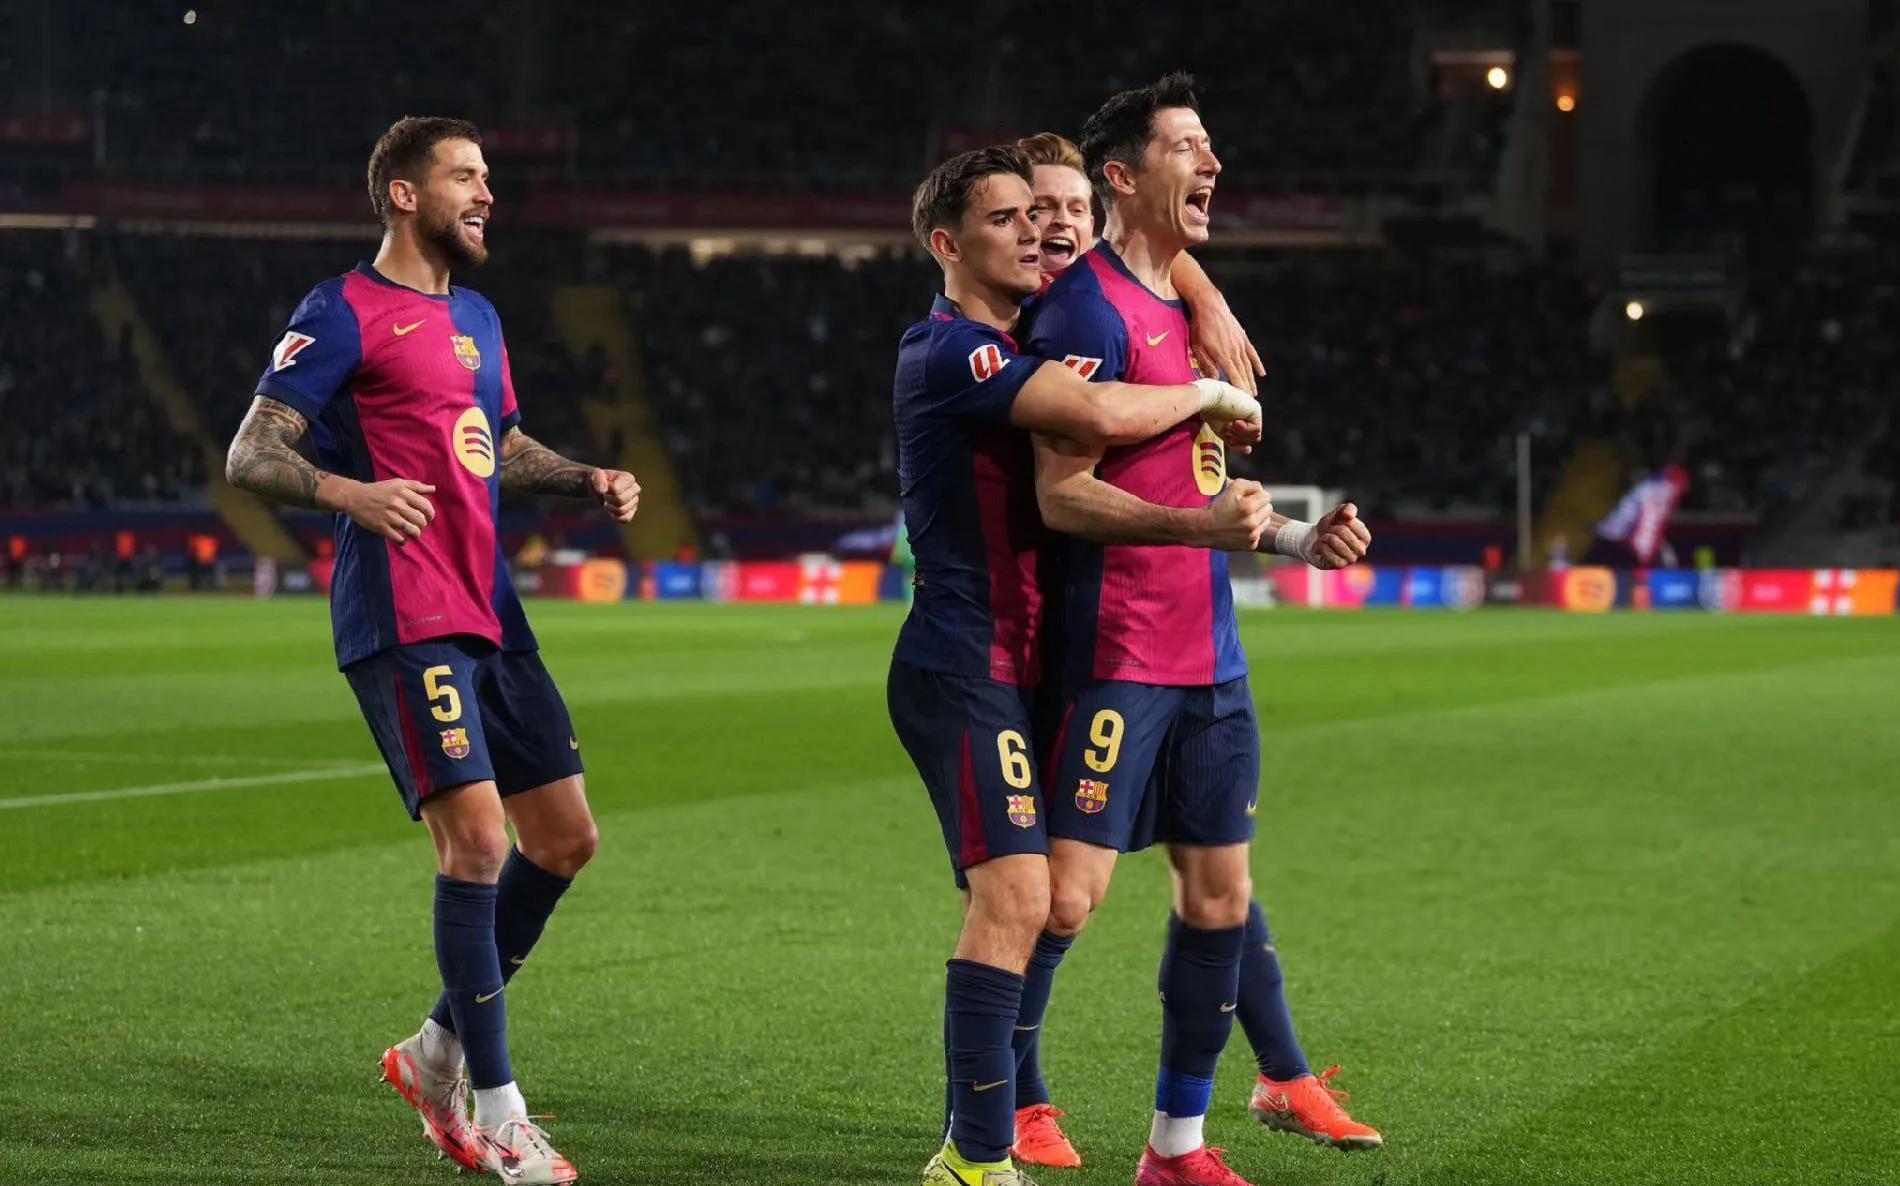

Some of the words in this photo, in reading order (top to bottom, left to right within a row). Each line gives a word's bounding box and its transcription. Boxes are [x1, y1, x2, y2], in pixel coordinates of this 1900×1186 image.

[423, 665, 461, 722] 5
[997, 729, 1031, 789] 6
[1084, 709, 1125, 773] 9
